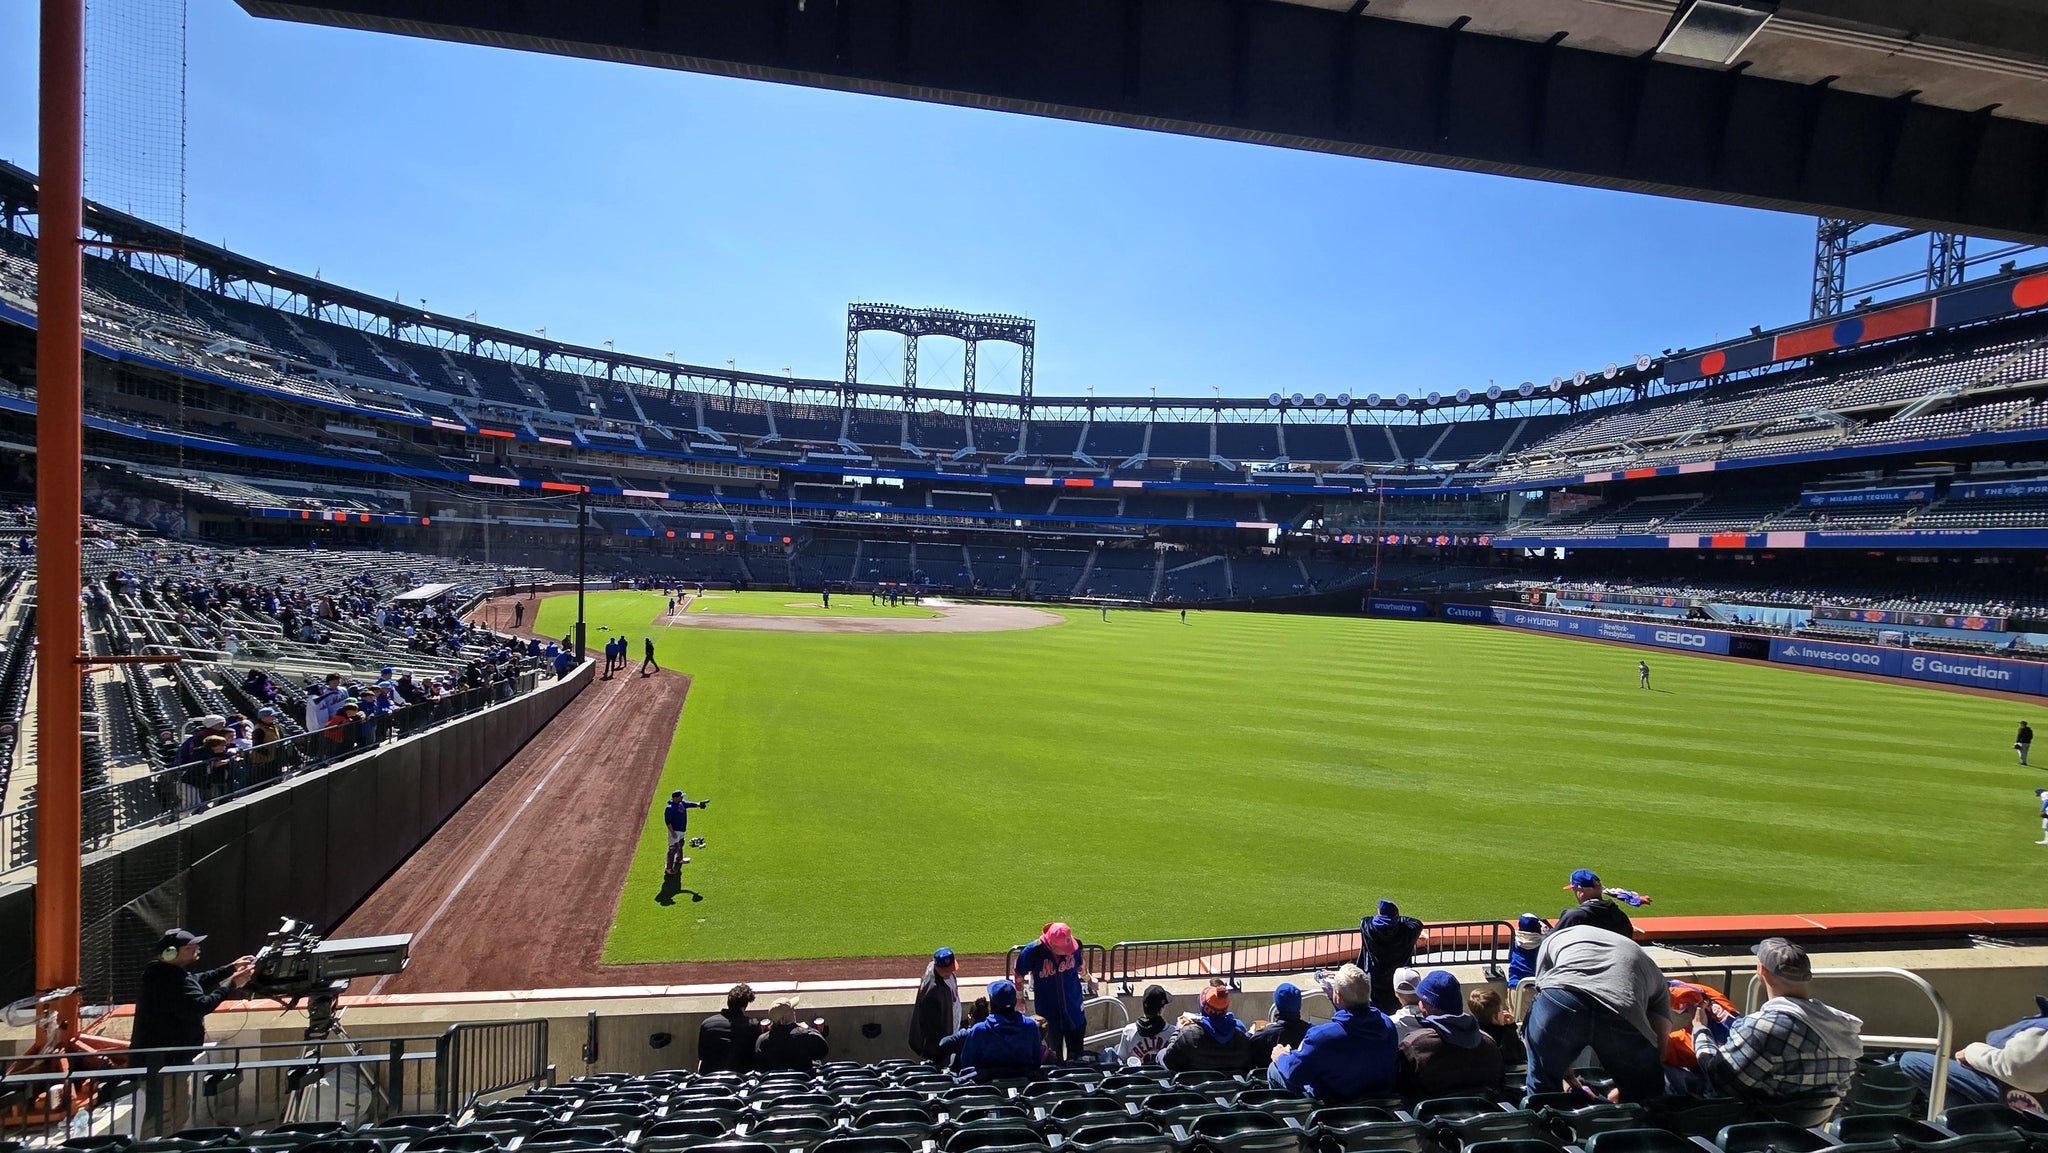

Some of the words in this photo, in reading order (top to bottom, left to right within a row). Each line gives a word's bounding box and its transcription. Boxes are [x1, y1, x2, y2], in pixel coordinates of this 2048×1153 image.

[1639, 358, 1648, 367] 42
[1490, 389, 1498, 397] 14
[1521, 385, 1531, 394] 37
[1430, 395, 1438, 403] 31
[1459, 392, 1467, 400] 41
[1374, 602, 1410, 611] smartwater
[1446, 607, 1482, 618] Canon
[1527, 617, 1559, 628] HYUNDAI
[1569, 622, 1579, 630] 358
[1603, 629, 1636, 640] Presbyterian
[1655, 630, 1706, 647] GEICO
[1802, 647, 1849, 662] Invesco
[1851, 652, 1881, 666] QQQ
[1928, 660, 2010, 681] Guardian
